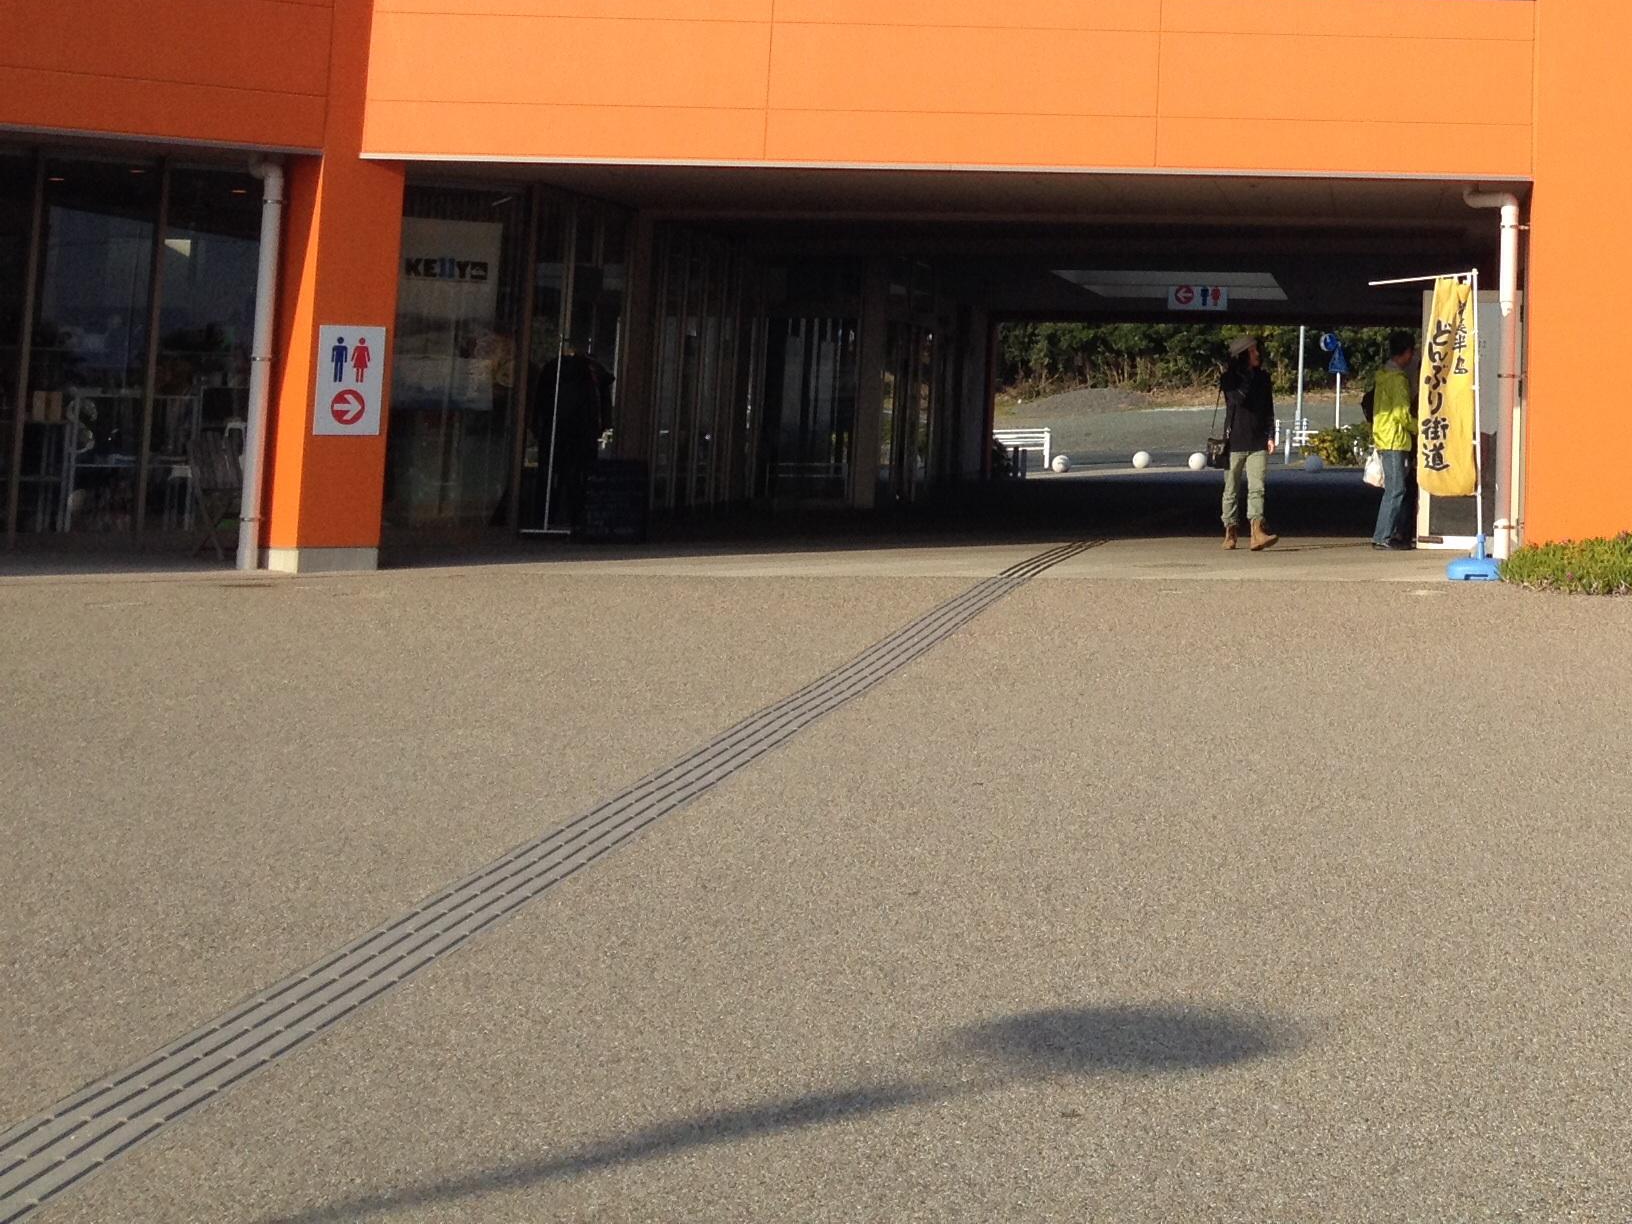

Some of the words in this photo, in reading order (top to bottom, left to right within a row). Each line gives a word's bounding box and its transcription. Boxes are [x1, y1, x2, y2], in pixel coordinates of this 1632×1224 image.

[1421, 319, 1451, 472] どんぶり街道
